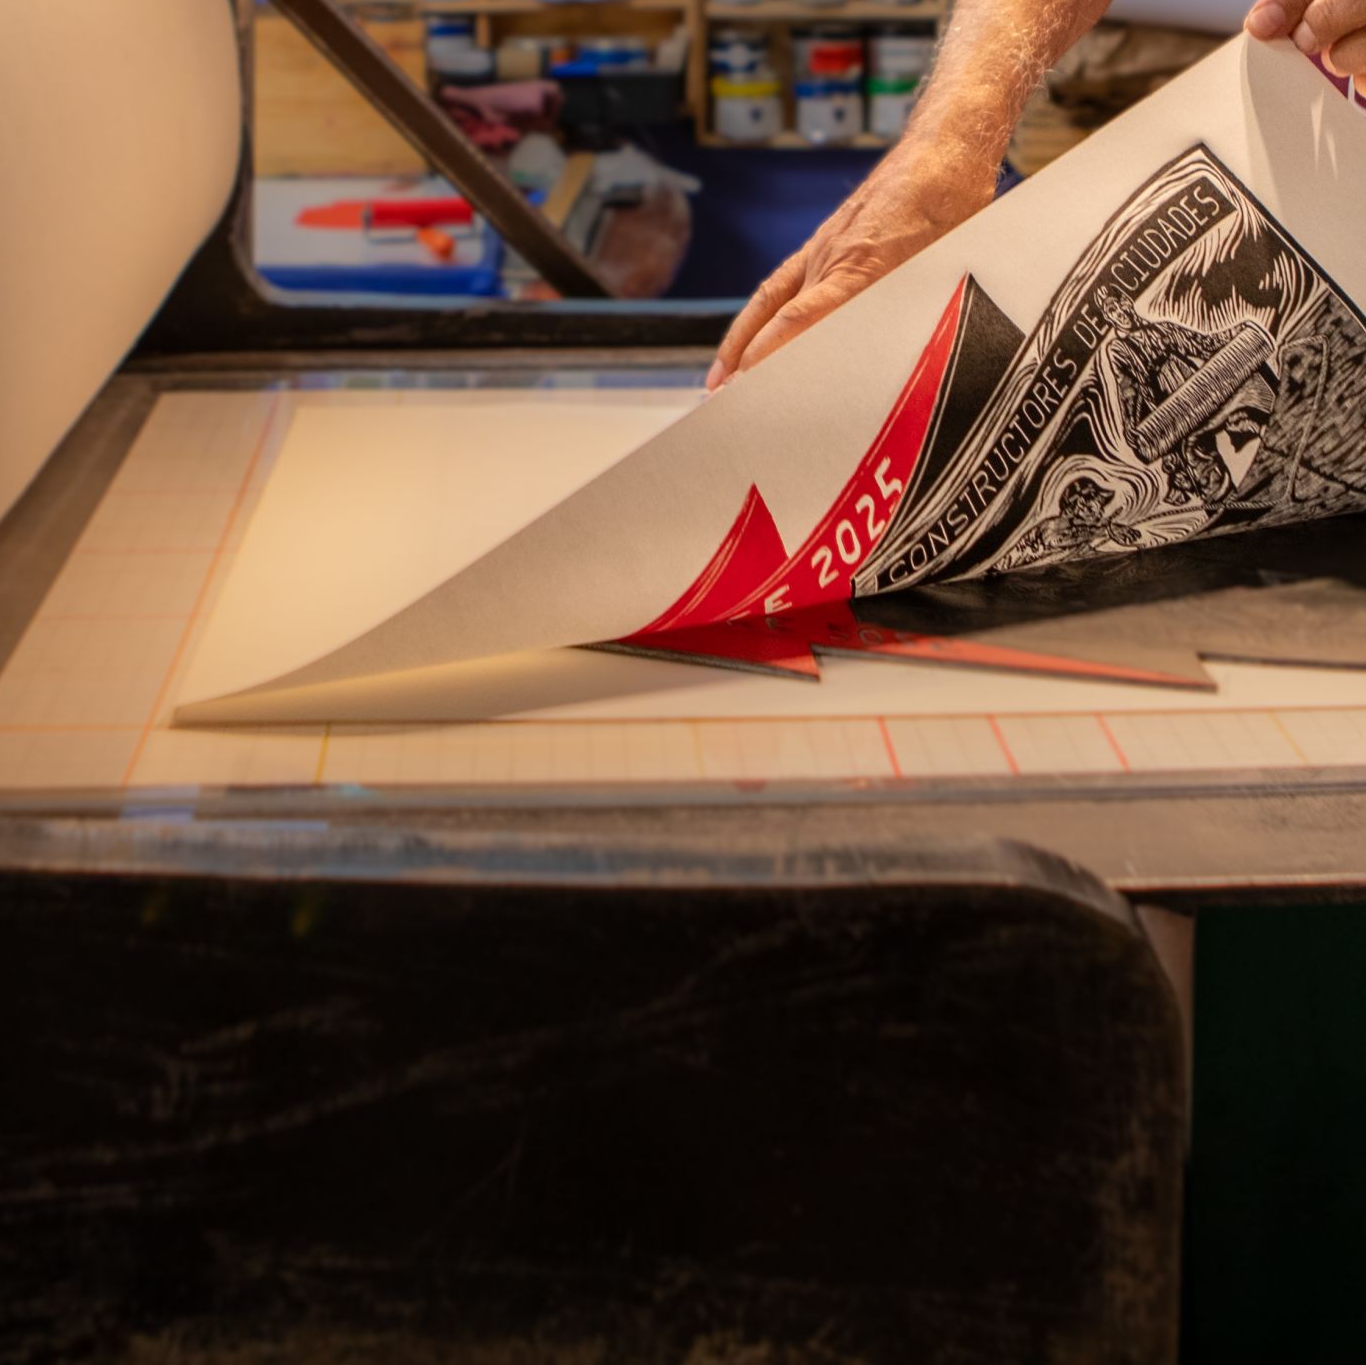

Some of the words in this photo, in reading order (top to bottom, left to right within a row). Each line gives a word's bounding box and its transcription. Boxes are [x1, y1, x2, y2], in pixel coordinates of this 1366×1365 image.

[888, 347, 1078, 583] CONSTRUCTORES
[1072, 303, 1110, 350] DE
[1110, 185, 1221, 292] CIUDADES
[810, 456, 903, 589] 2025
